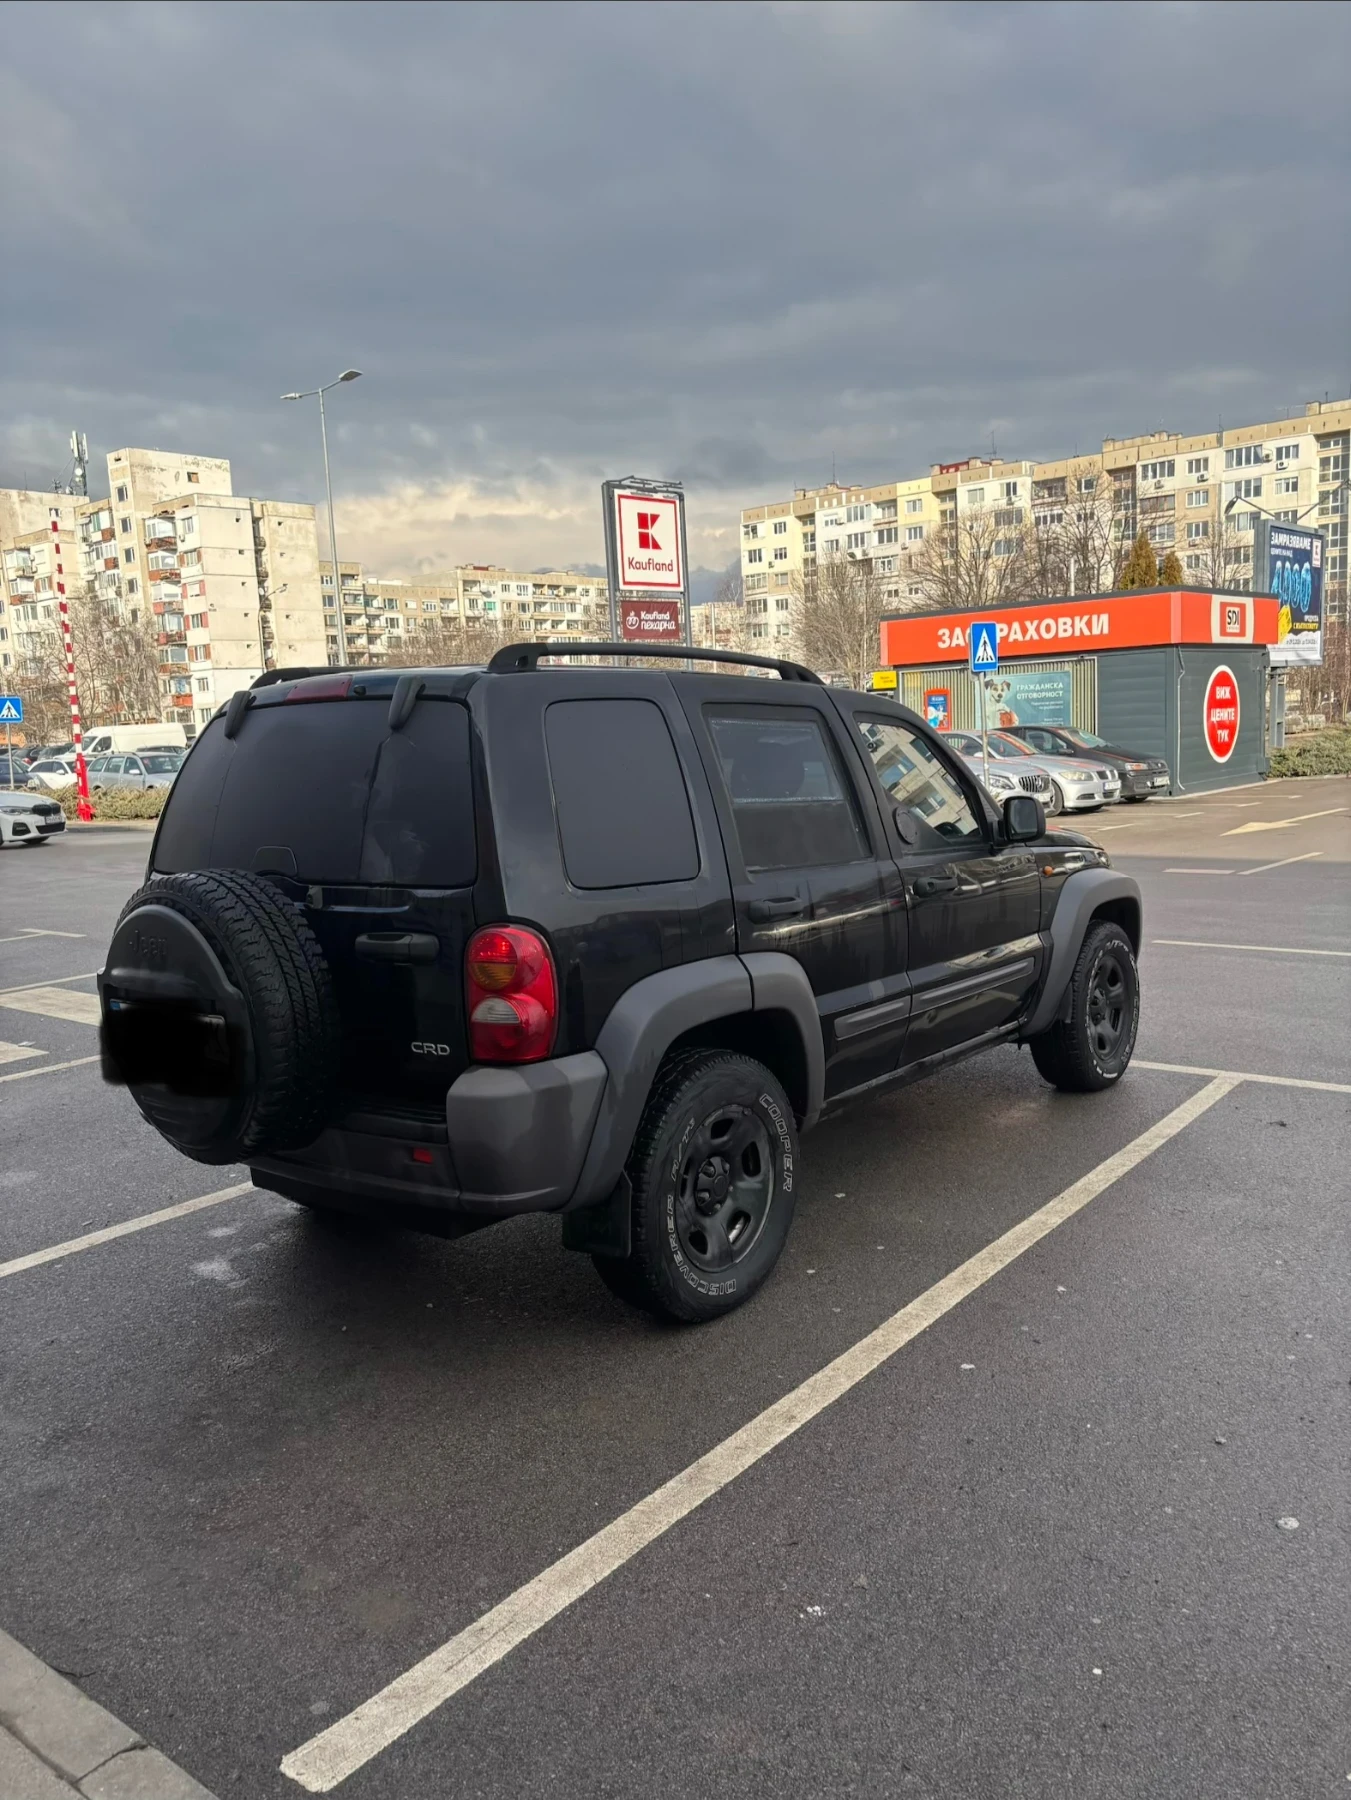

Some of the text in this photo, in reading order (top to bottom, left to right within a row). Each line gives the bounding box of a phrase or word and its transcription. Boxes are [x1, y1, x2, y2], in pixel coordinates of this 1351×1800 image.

[628, 557, 673, 572] Kaufland
[641, 611, 670, 620] Kaufland
[1227, 609, 1240, 625] SDI
[641, 620, 676, 632] пекарна
[937, 613, 1109, 649] ЗАРАХОВКИ
[1016, 682, 1064, 691] ГРАЖДАНСКА
[1215, 686, 1231, 699] ВИЖ
[1016, 691, 1064, 700] ОТГОВОРНОСТ
[1210, 708, 1235, 723] ЦЕНИТЕ
[1217, 729, 1230, 742] ТУК
[411, 1041, 450, 1056] CRD
[759, 1093, 793, 1192] COOPER
[667, 1195, 736, 1296] DISCOVERER
